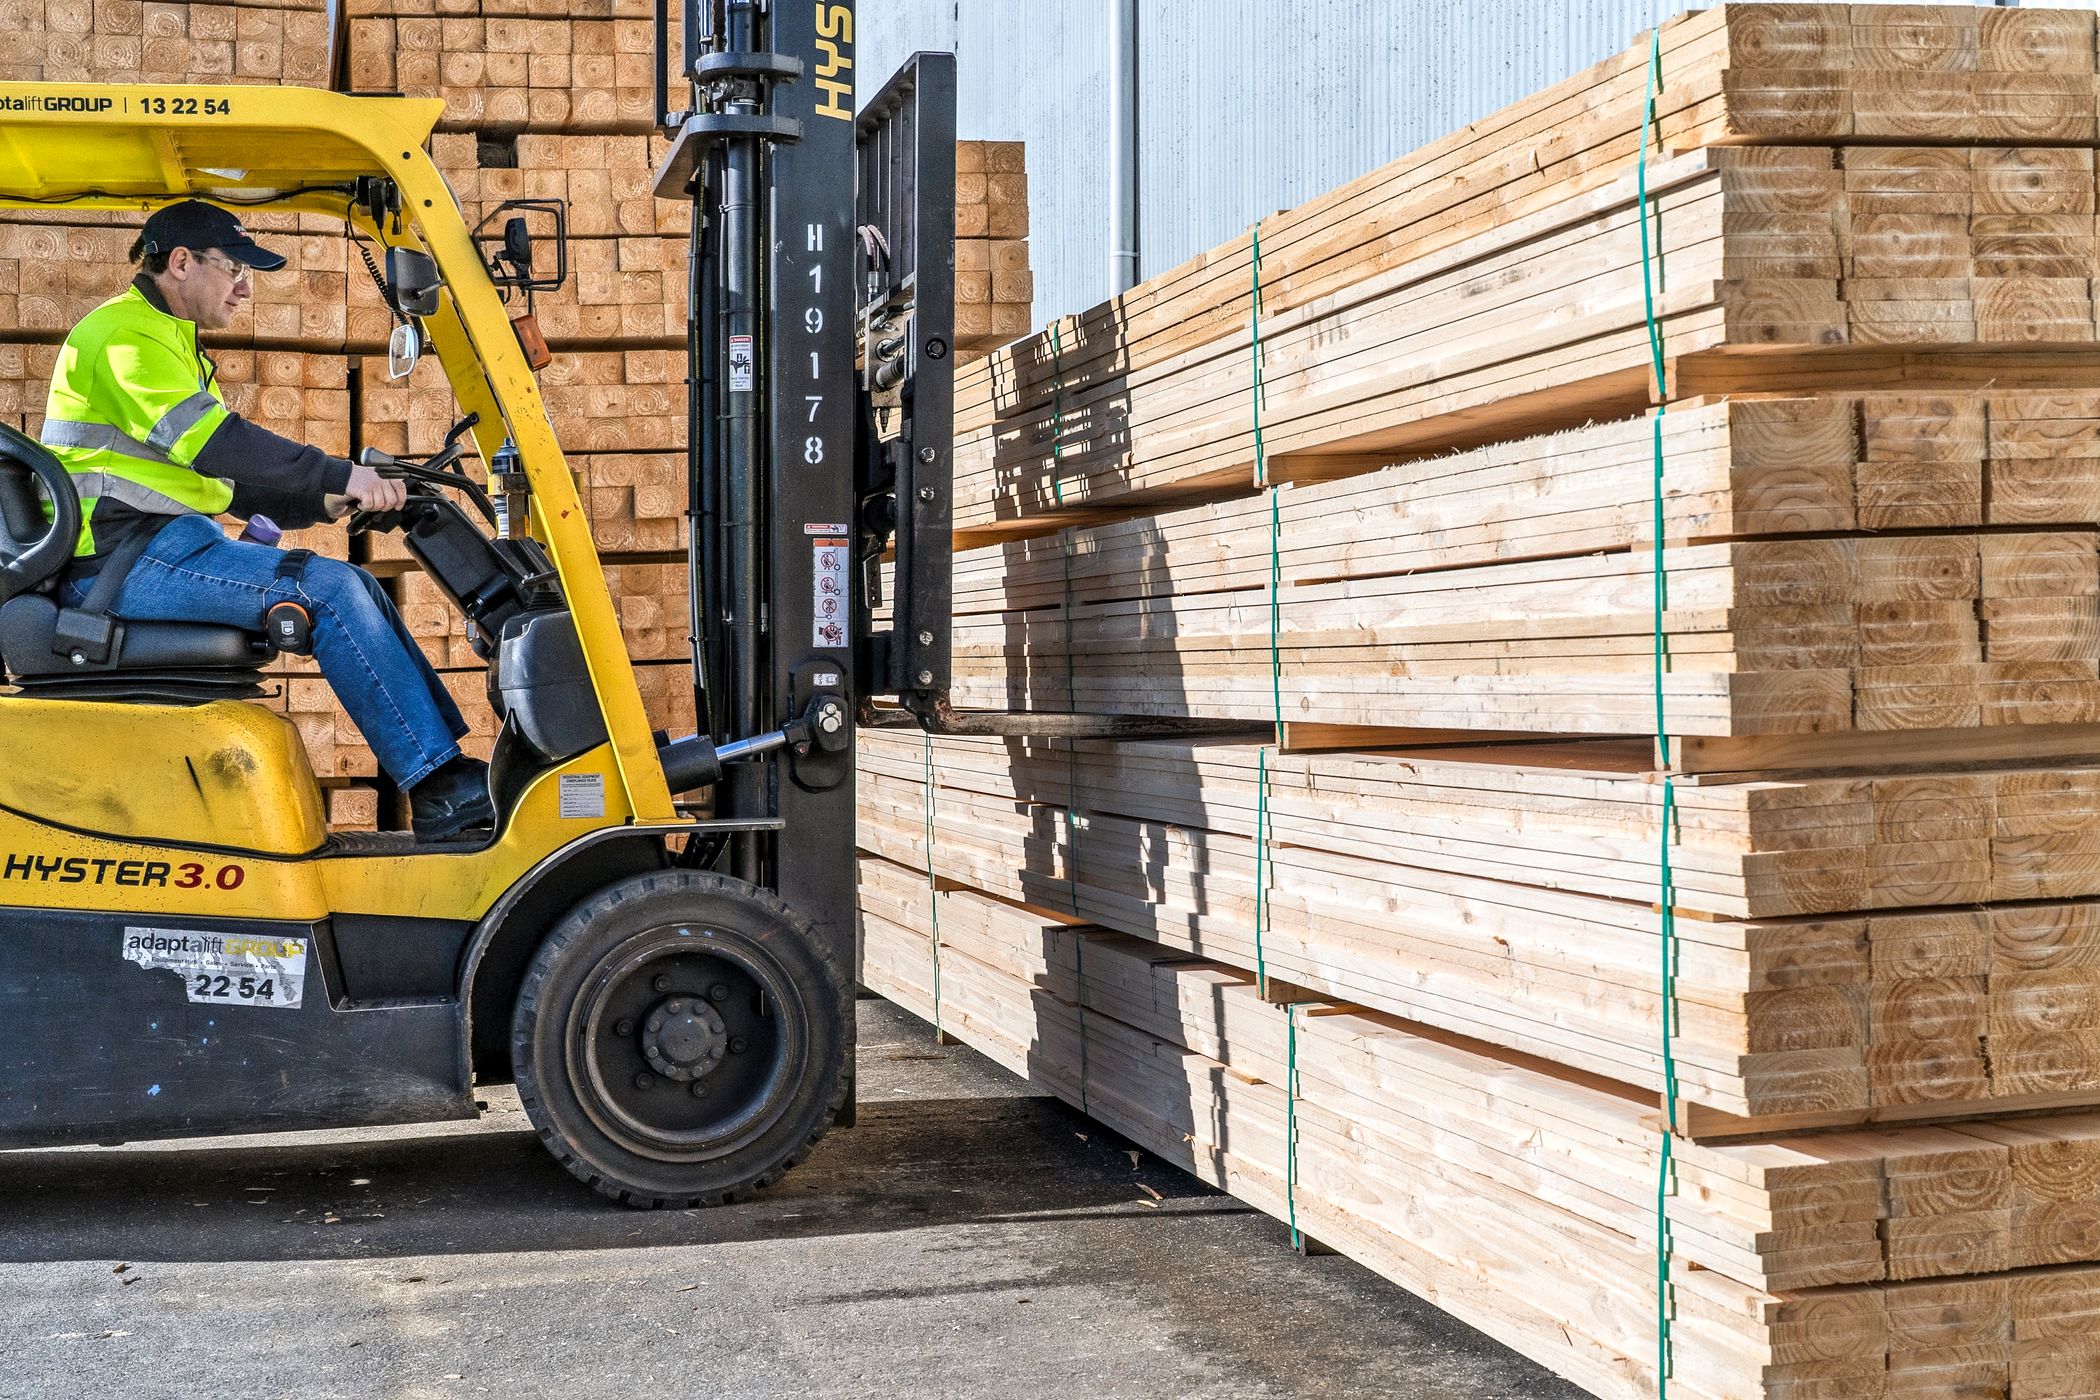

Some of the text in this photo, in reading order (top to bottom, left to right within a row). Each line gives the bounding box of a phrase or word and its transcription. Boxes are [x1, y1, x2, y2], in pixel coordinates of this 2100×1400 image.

[815, 0, 853, 121] HYS
[140, 98, 166, 114] 13
[172, 99, 198, 115] 22
[204, 99, 230, 116] 54
[3, 853, 246, 891] HYSTER 3.0
[194, 974, 275, 1000] 22 54
